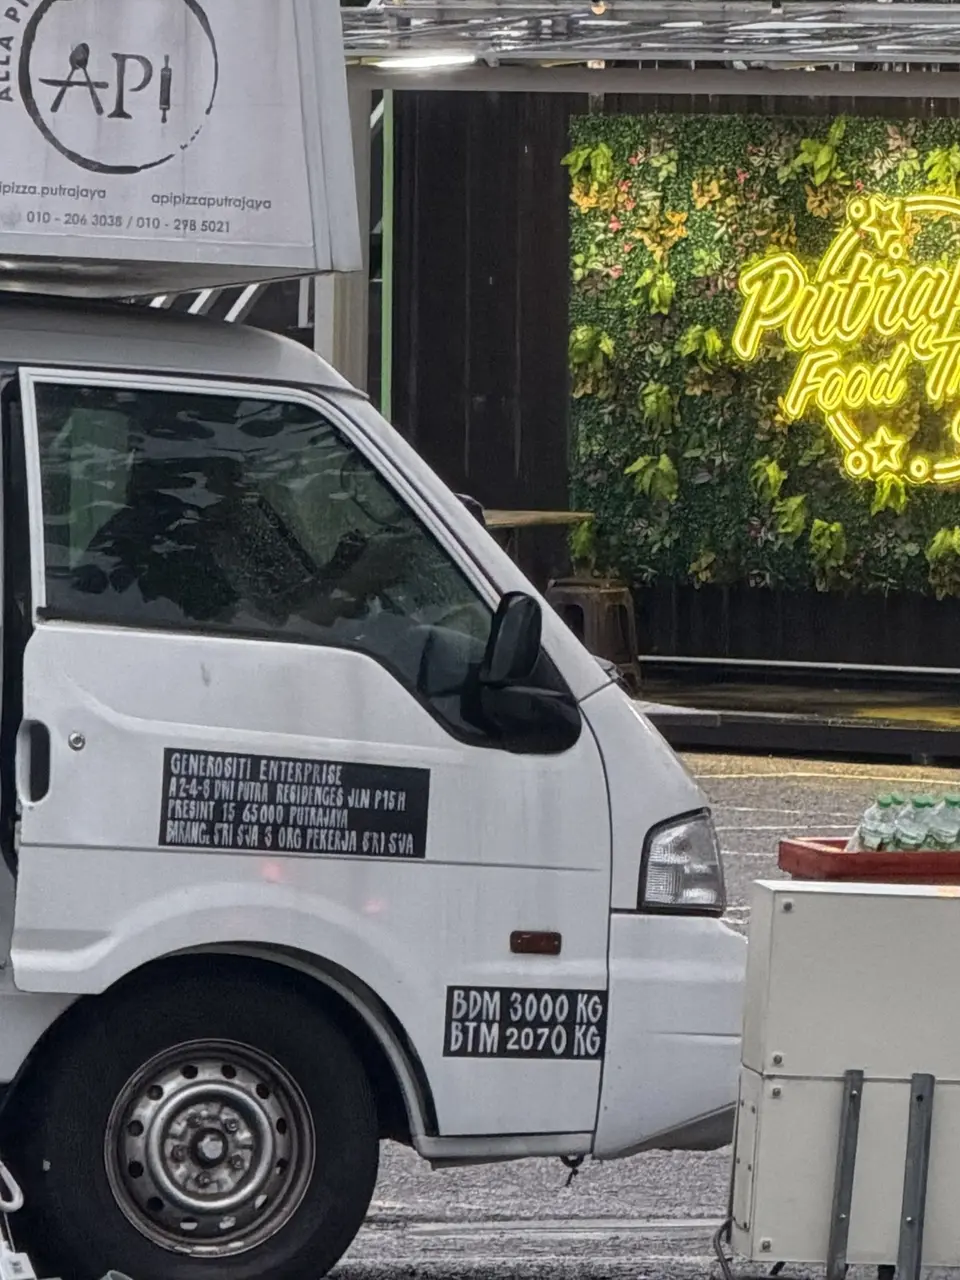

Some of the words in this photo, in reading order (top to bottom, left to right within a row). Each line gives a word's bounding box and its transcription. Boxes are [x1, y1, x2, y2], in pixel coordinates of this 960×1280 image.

[0, 35, 14, 102] ALLA
[27, 211, 51, 223] 010
[64, 213, 87, 226] 206
[136, 217, 160, 229] 010
[201, 220, 230, 233] 5021
[784, 342, 908, 418] Food
[170, 752, 251, 780] GENEROSITI
[260, 759, 342, 786] ENTERPRISE
[237, 780, 268, 803] PUTRA
[167, 798, 215, 822] PRESINT
[223, 802, 236, 822] 15
[242, 803, 284, 825] 65000
[289, 806, 348, 829] PUTRAJAYA
[278, 827, 302, 849] ORG
[306, 828, 357, 852] PEKERJA
[452, 989, 501, 1021] BDM
[509, 991, 569, 1022] 3000
[575, 993, 603, 1023] KG
[450, 1021, 500, 1053] BTM
[505, 1024, 567, 1055] 2070
[573, 1024, 601, 1056] KG
